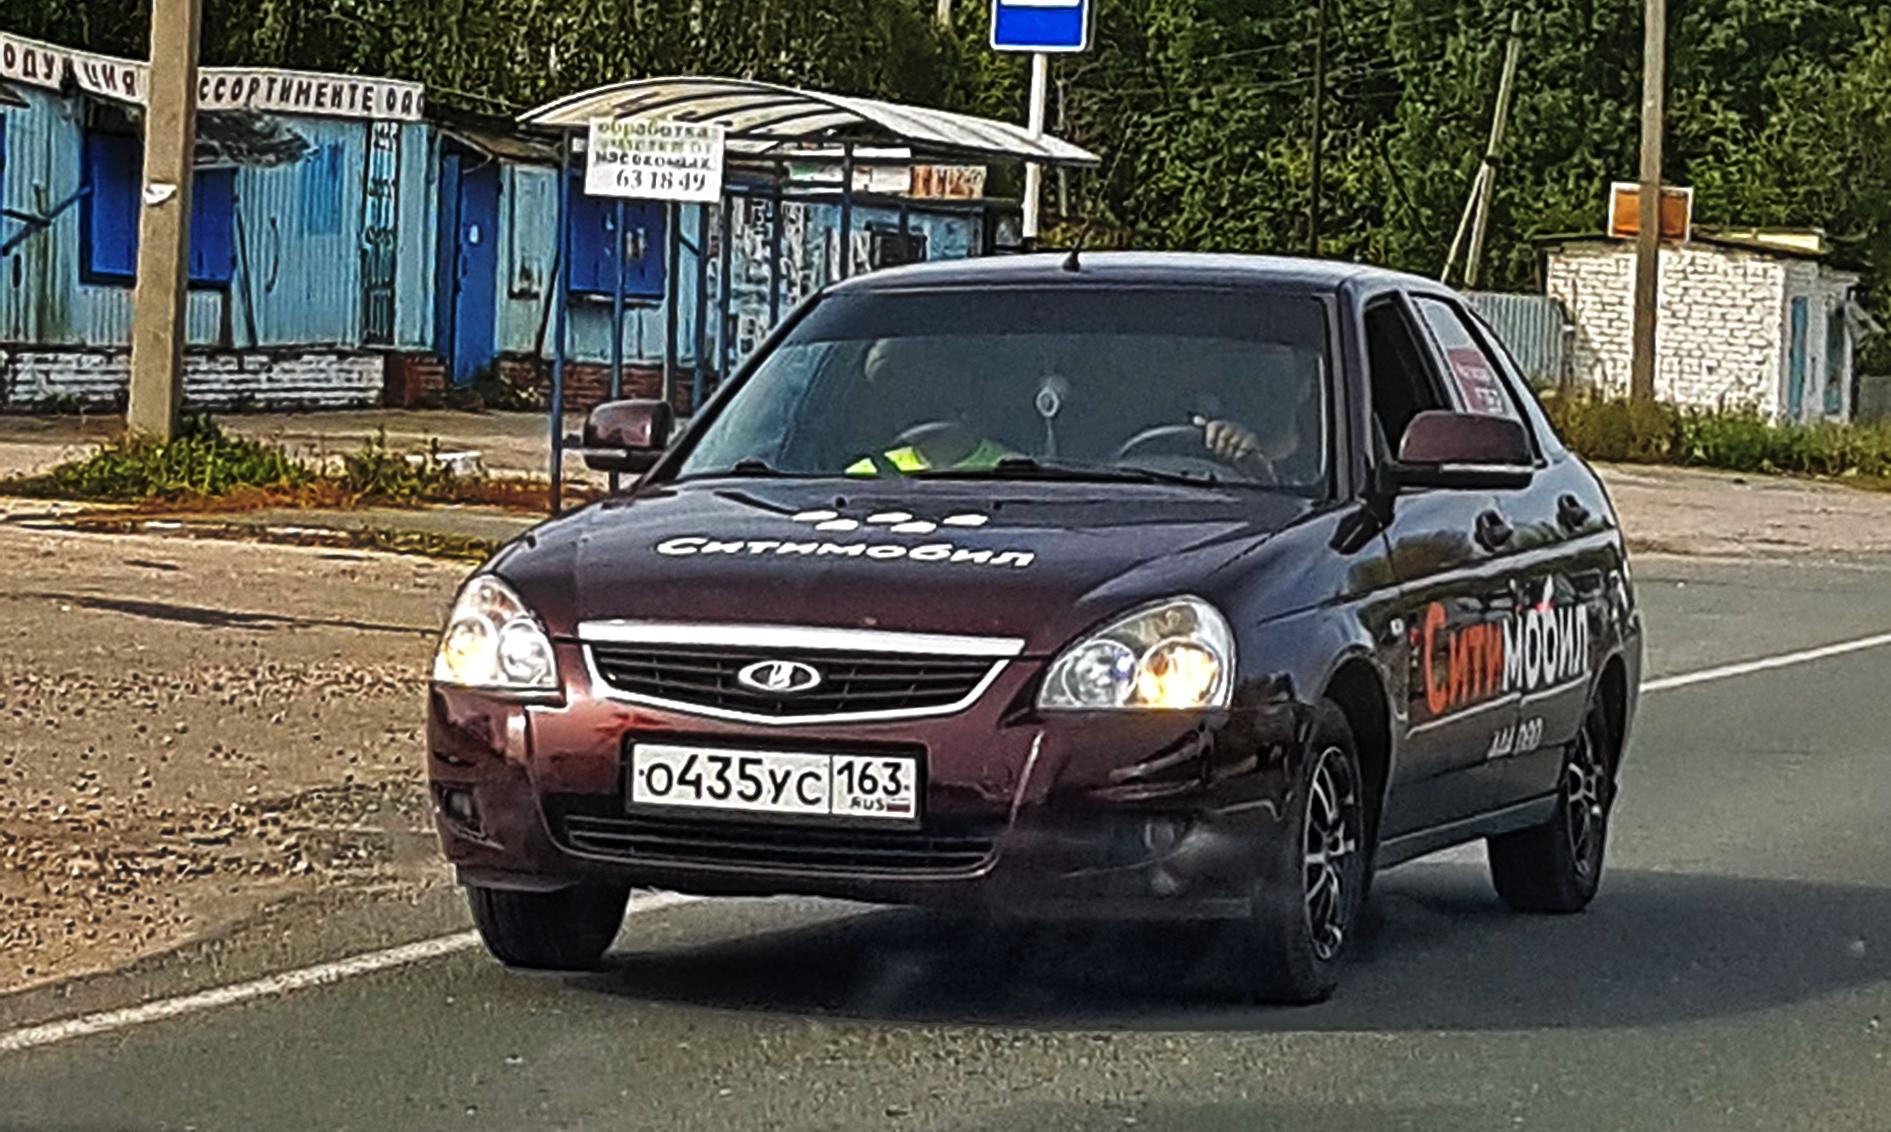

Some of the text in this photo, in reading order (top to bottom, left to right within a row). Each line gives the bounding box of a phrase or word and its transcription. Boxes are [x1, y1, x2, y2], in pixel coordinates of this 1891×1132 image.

[656, 537, 1035, 567] Ситимобил
[836, 760, 903, 797] 163
[850, 796, 885, 811] RUS
